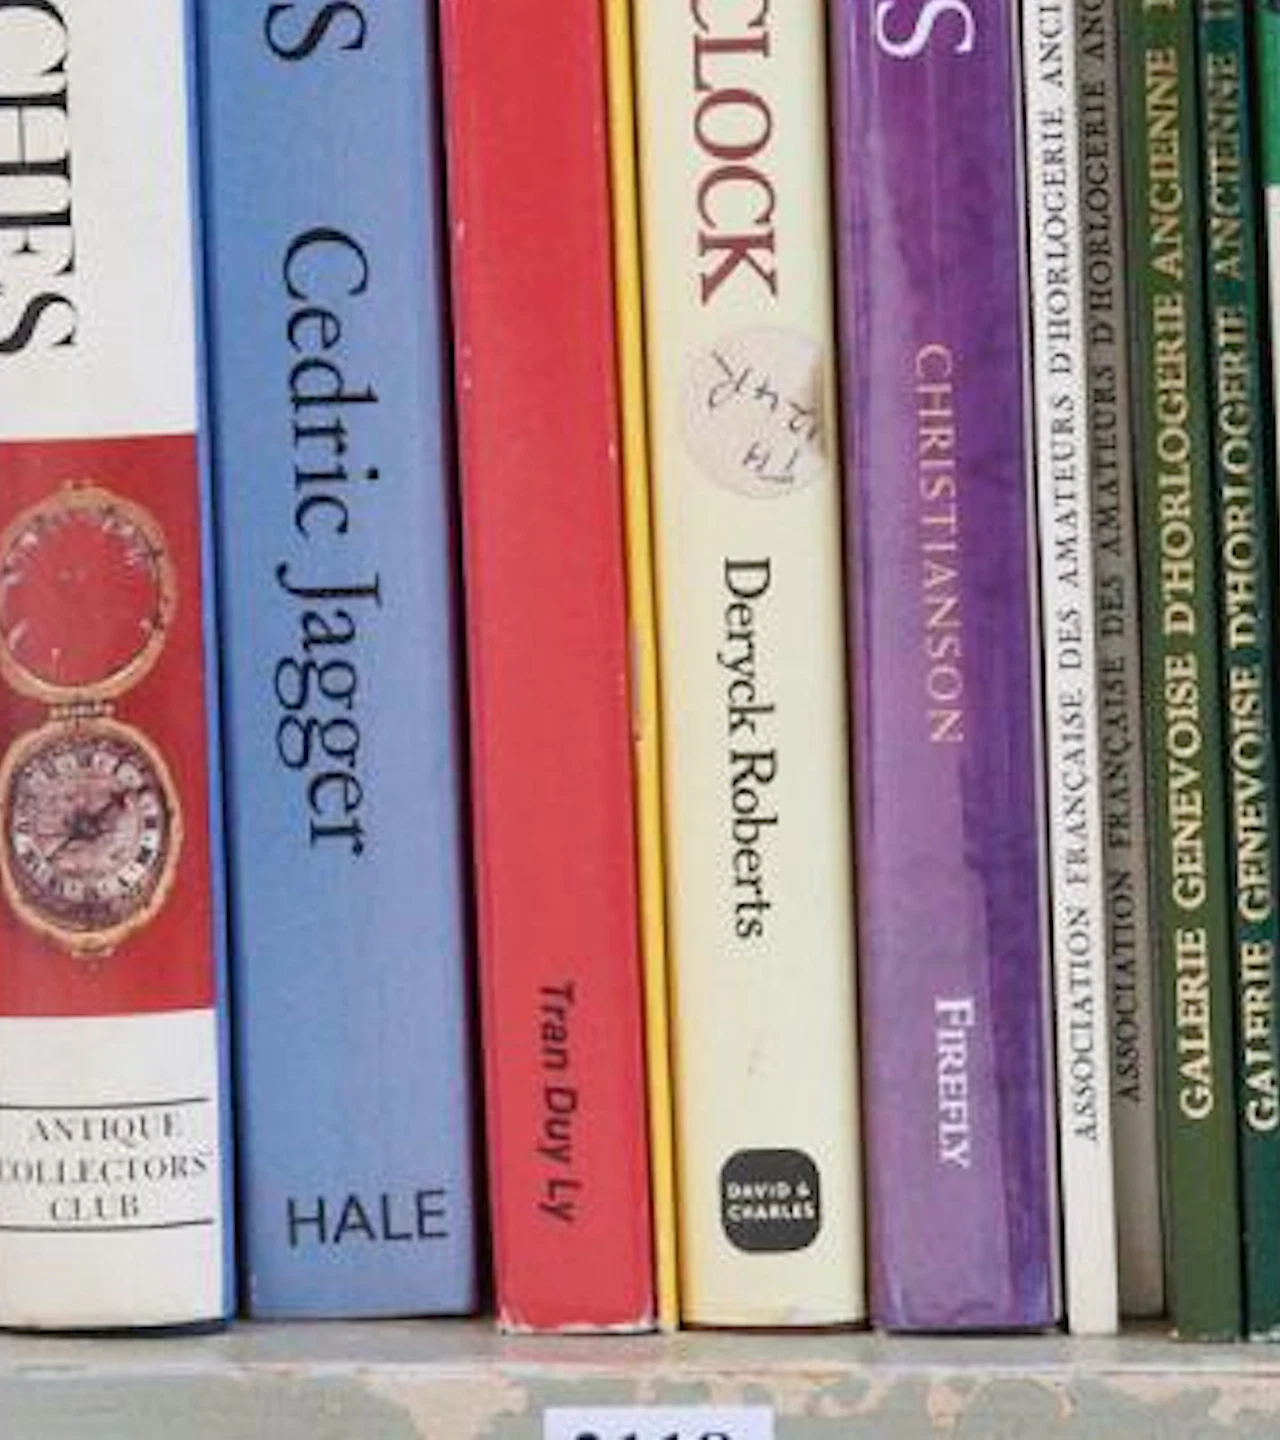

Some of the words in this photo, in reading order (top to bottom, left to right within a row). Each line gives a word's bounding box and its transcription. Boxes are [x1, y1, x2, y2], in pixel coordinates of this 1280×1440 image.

[1145, 48, 1183, 281] ANCIENNE
[1207, 52, 1247, 281] ANCIENNE
[282, 227, 380, 535] Cedric
[1093, 365, 1122, 558] AMATEURS
[1152, 293, 1197, 637] D'HORLOGERIE
[916, 343, 965, 743] CHRISTIANSON
[1049, 393, 1079, 588] AMATEURS
[718, 556, 776, 736] Deryck
[1057, 609, 1084, 670] DES
[1098, 574, 1124, 638] DES
[275, 561, 383, 859] Jagger
[1057, 688, 1089, 886] FRANÇAISE
[1100, 657, 1132, 851] FRANÇAISE
[1164, 653, 1207, 909] GENEVOISE
[1230, 665, 1274, 922] GENEVOISE
[728, 748, 780, 940] Roberts
[539, 980, 576, 1072] Tran
[934, 997, 975, 1169] FIREFLY
[1063, 906, 1096, 1142] ASSOCIATION
[1108, 869, 1141, 1104] ASSOCIATION
[1175, 926, 1215, 1121] GALERIE
[1240, 939, 1280, 1132] GALERIE
[29, 1112, 184, 1148] ANTIQUE
[49, 1195, 140, 1224] CLUB
[287, 1189, 450, 1249] HALE
[536, 1085, 578, 1165] Duy
[537, 1178, 582, 1223] Ly
[727, 1181, 791, 1200] DAVID
[727, 1201, 816, 1221] CHARLES
